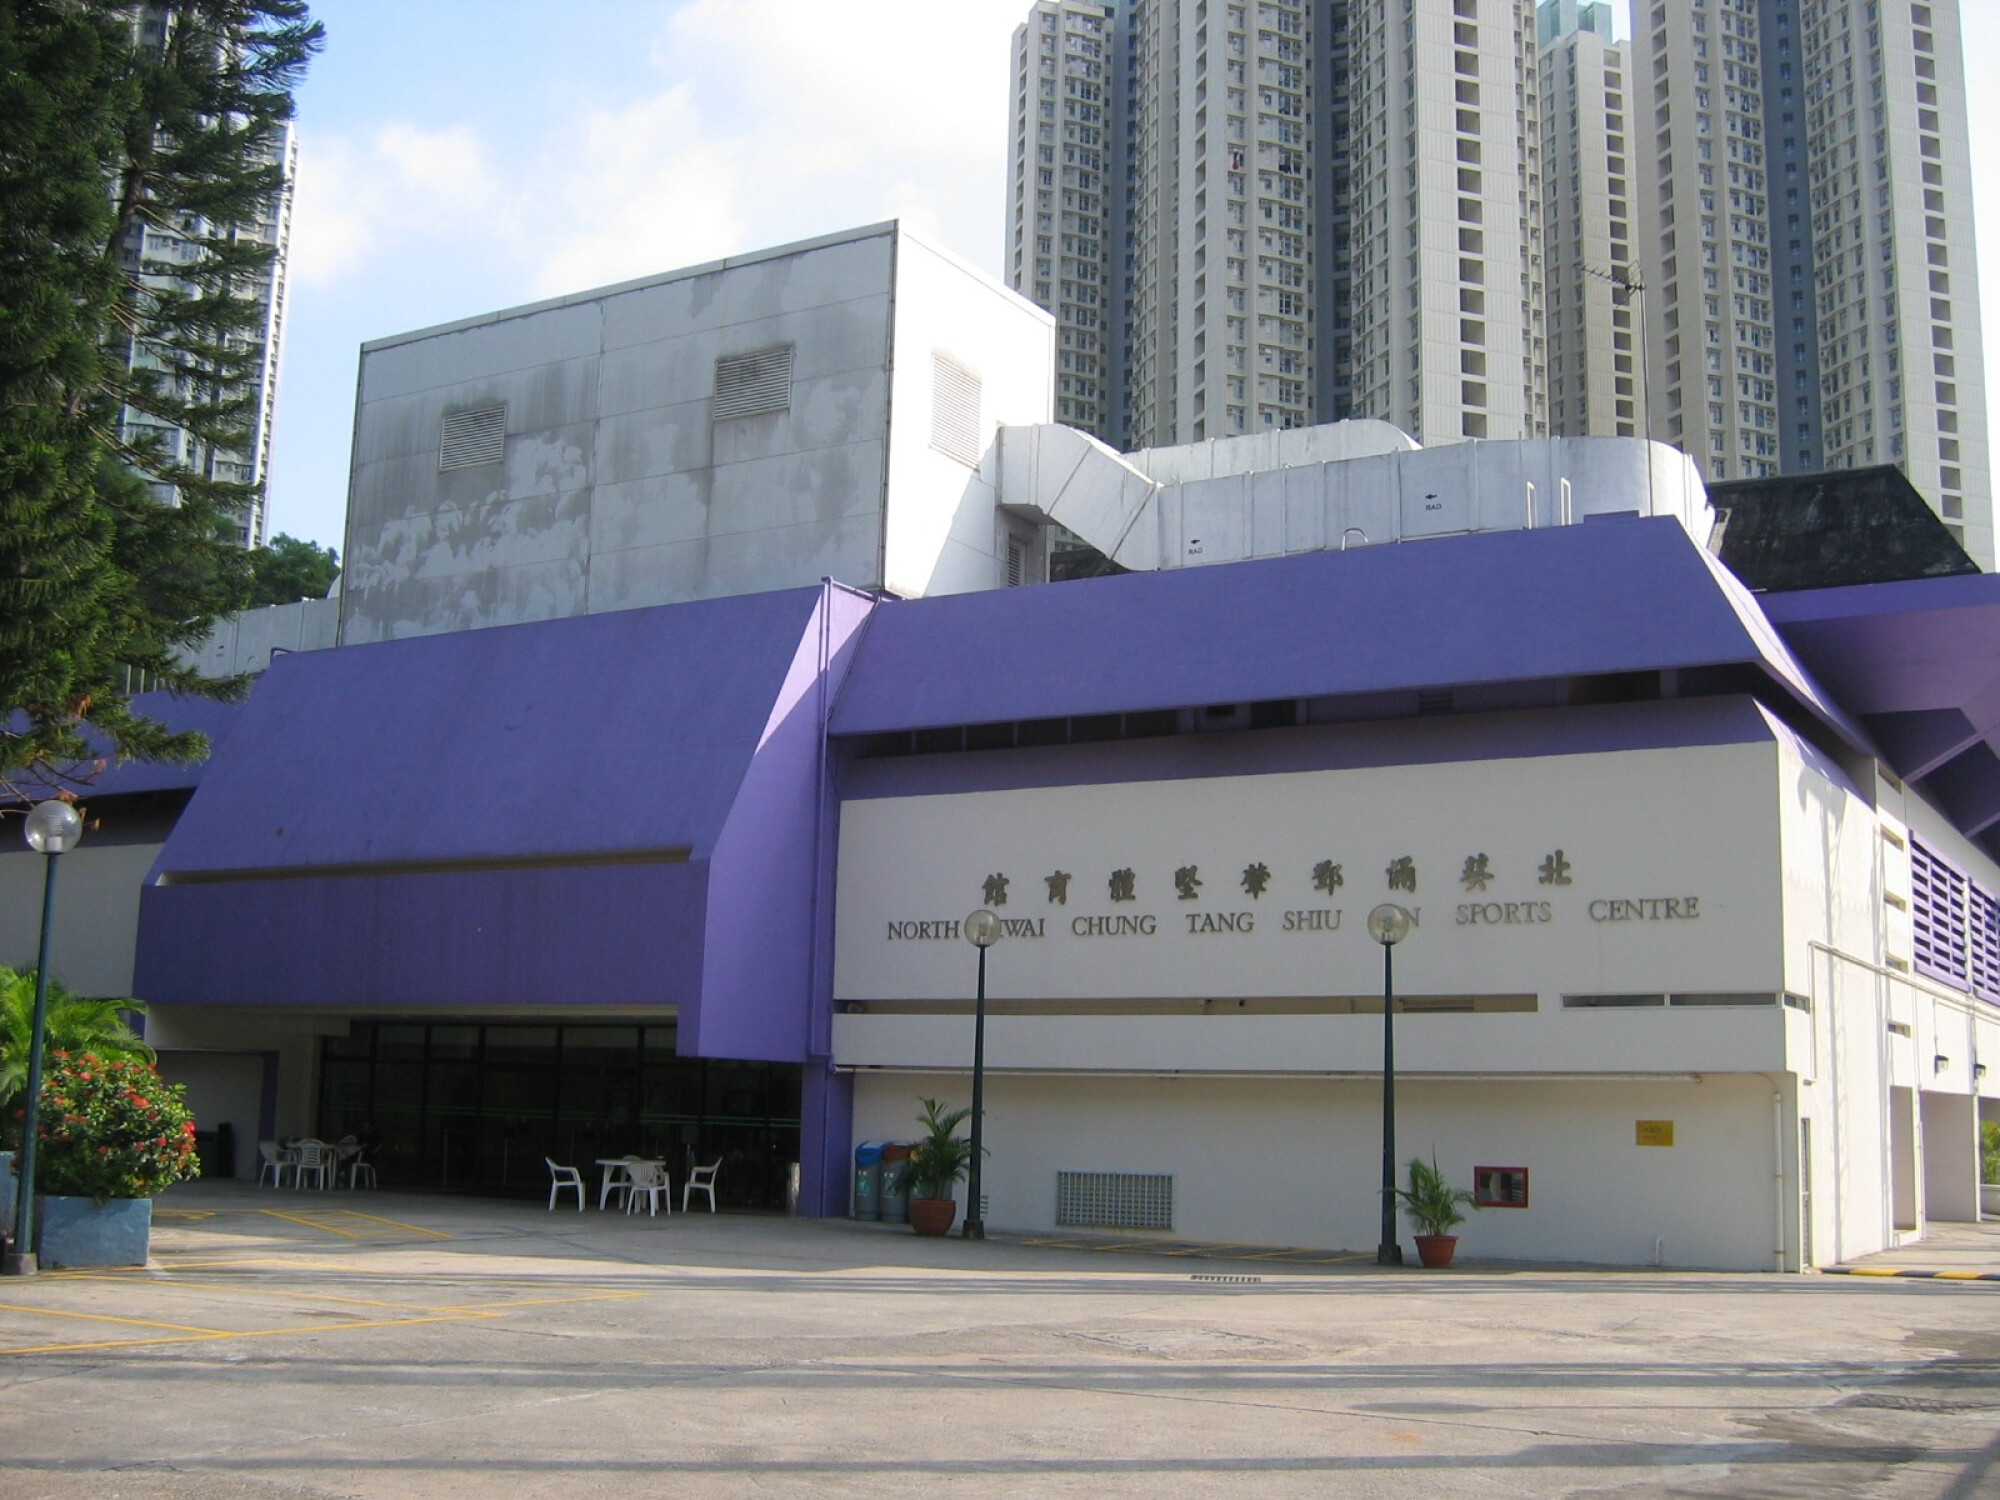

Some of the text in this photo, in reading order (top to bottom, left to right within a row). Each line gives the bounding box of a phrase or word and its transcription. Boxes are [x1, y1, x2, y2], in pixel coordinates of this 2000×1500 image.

[887, 920, 961, 941] NORTH
[996, 918, 1046, 938] WAI
[1072, 914, 1158, 936] CHUNG
[1185, 912, 1255, 934] TANG
[1282, 909, 1343, 931] SHIU
[1455, 900, 1552, 926] SPORTS
[1588, 896, 1701, 922] CENTRE
